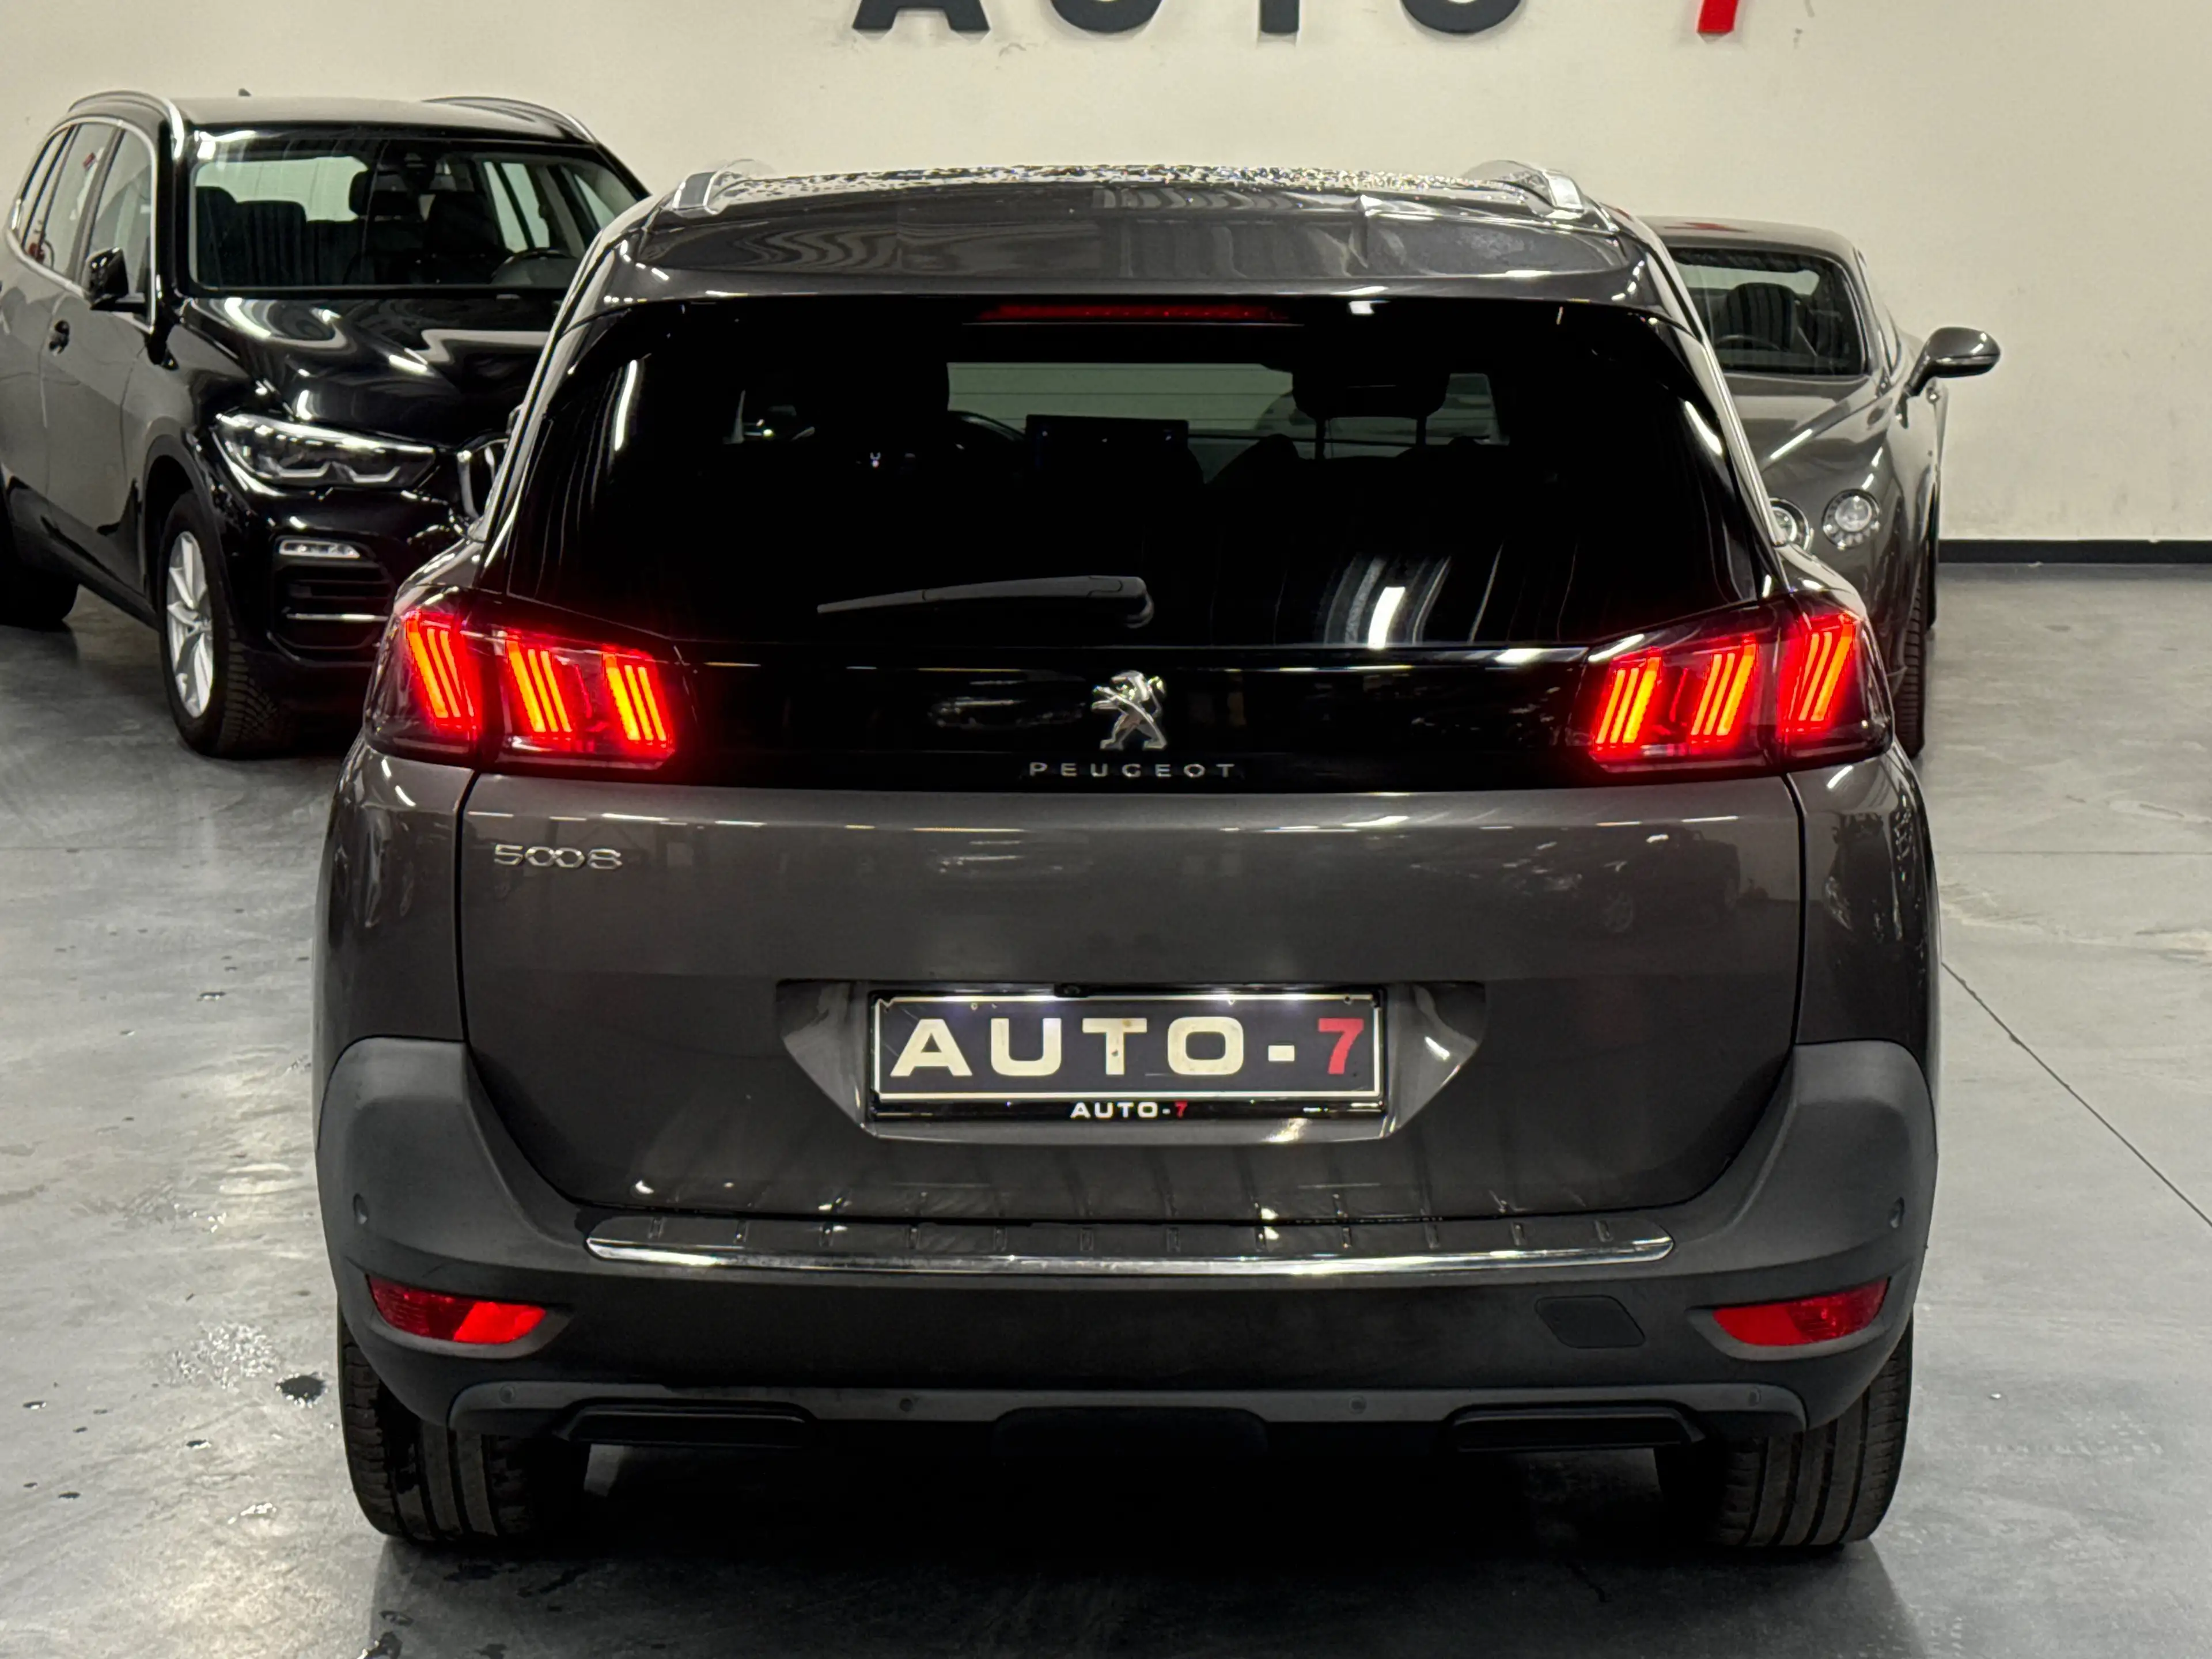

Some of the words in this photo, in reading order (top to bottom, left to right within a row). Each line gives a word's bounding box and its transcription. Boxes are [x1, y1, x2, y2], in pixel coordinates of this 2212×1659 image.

[1029, 762, 1235, 778] PEUGEOT
[494, 843, 623, 870] 5008
[890, 1016, 1364, 1077] AUTO-7
[1070, 1101, 1188, 1119] AUTO-7
